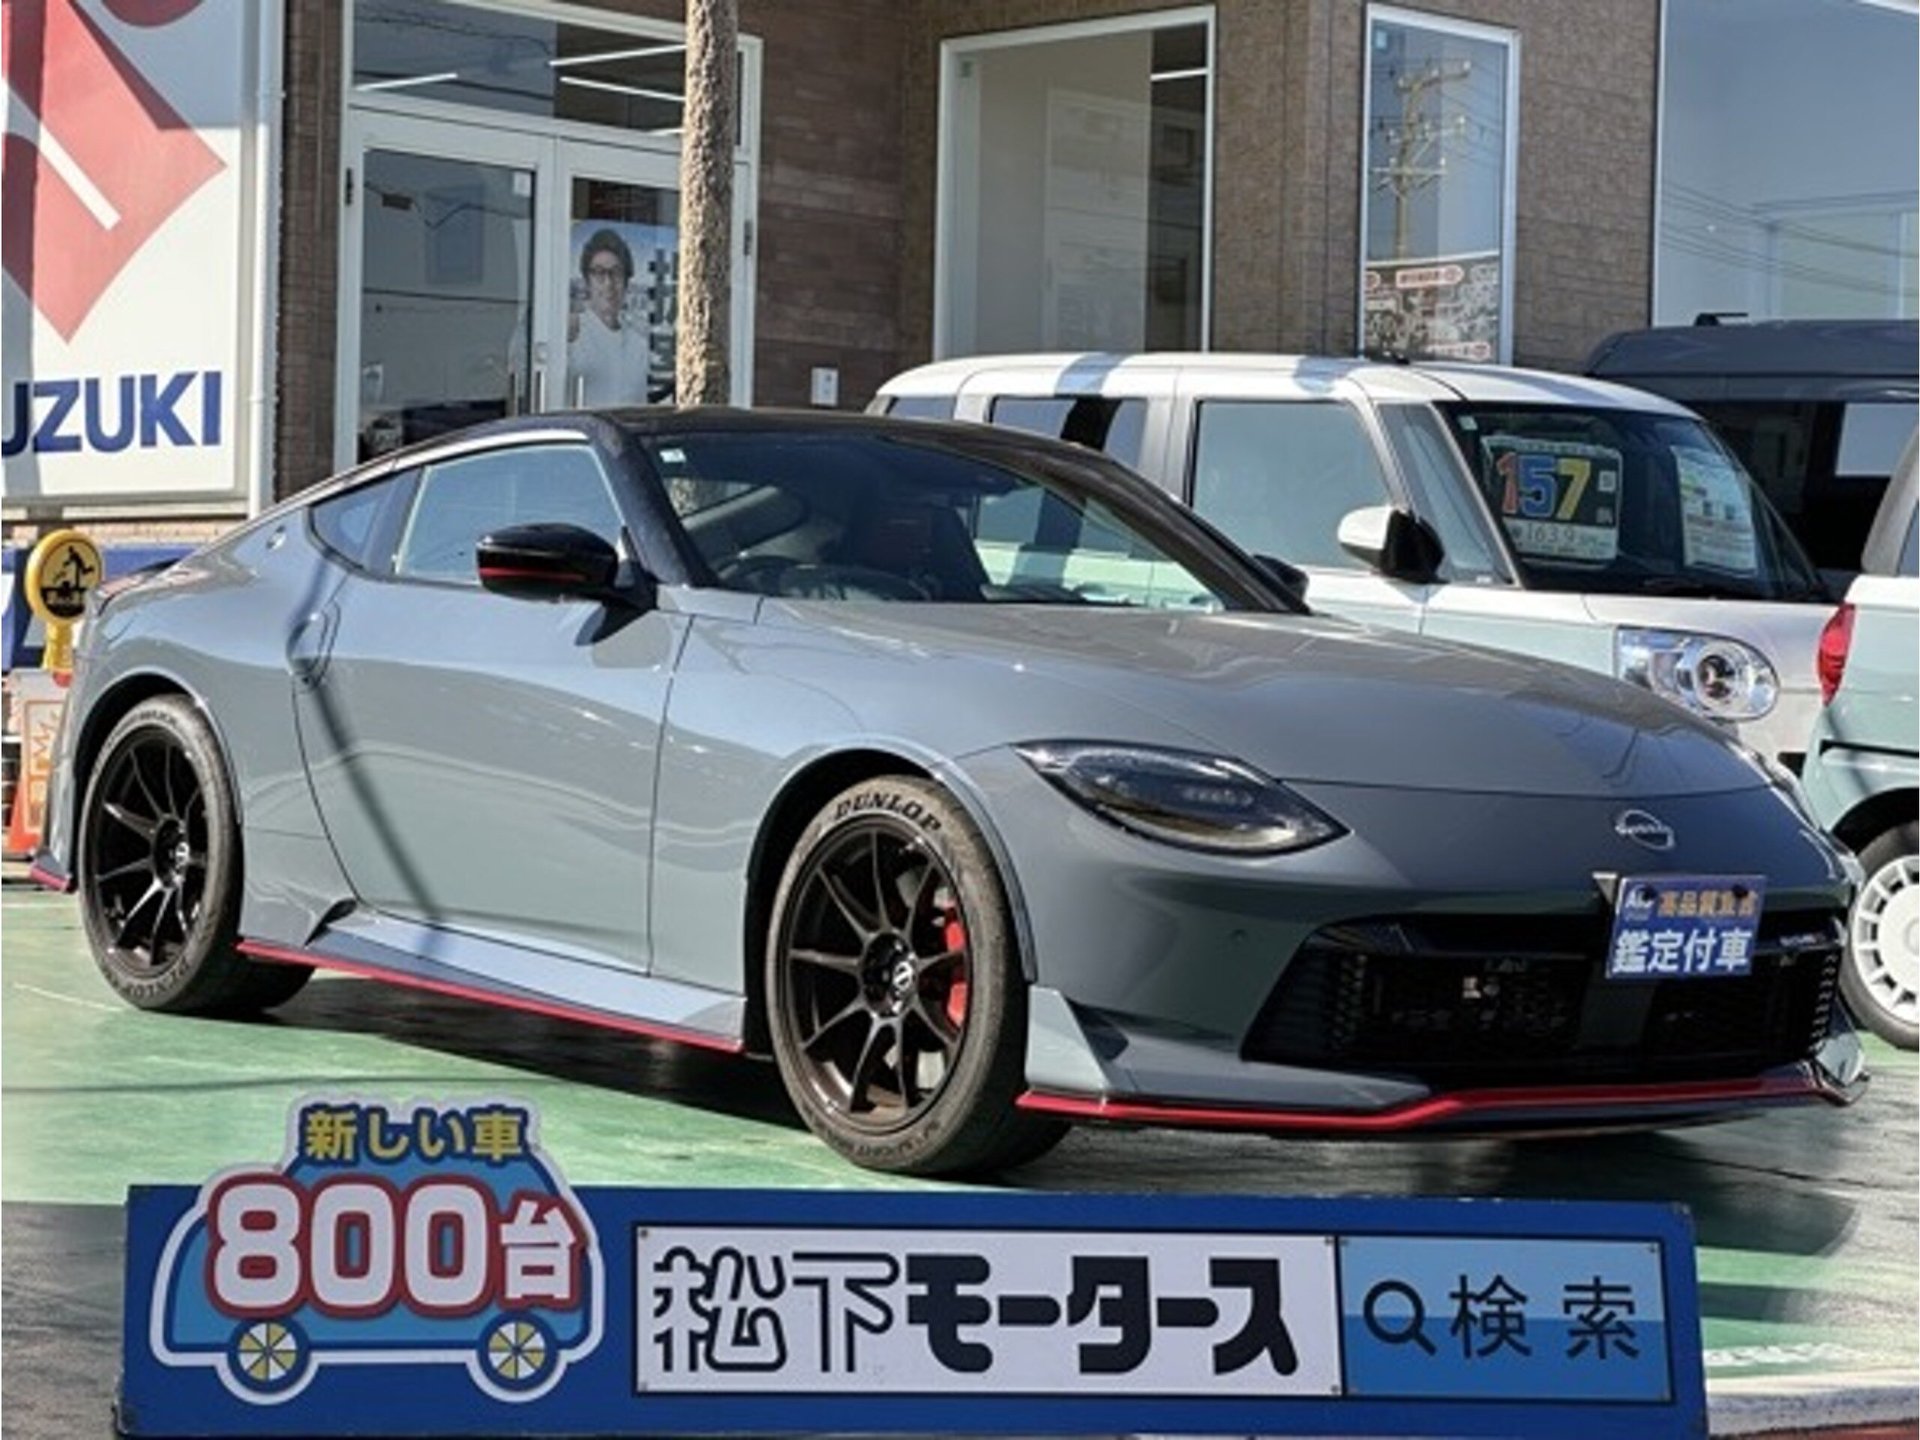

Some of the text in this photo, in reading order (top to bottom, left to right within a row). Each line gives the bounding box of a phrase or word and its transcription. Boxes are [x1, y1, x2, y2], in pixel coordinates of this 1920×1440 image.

[1496, 452, 1592, 520] 157
[834, 792, 942, 831] DUNLOP
[1612, 928, 1753, 973] 鑑定付車
[304, 1108, 525, 1161] 新しい車
[210, 1178, 580, 1312] 800台
[652, 1245, 1299, 1378] 松下モータース
[1449, 1274, 1639, 1359] 検索
